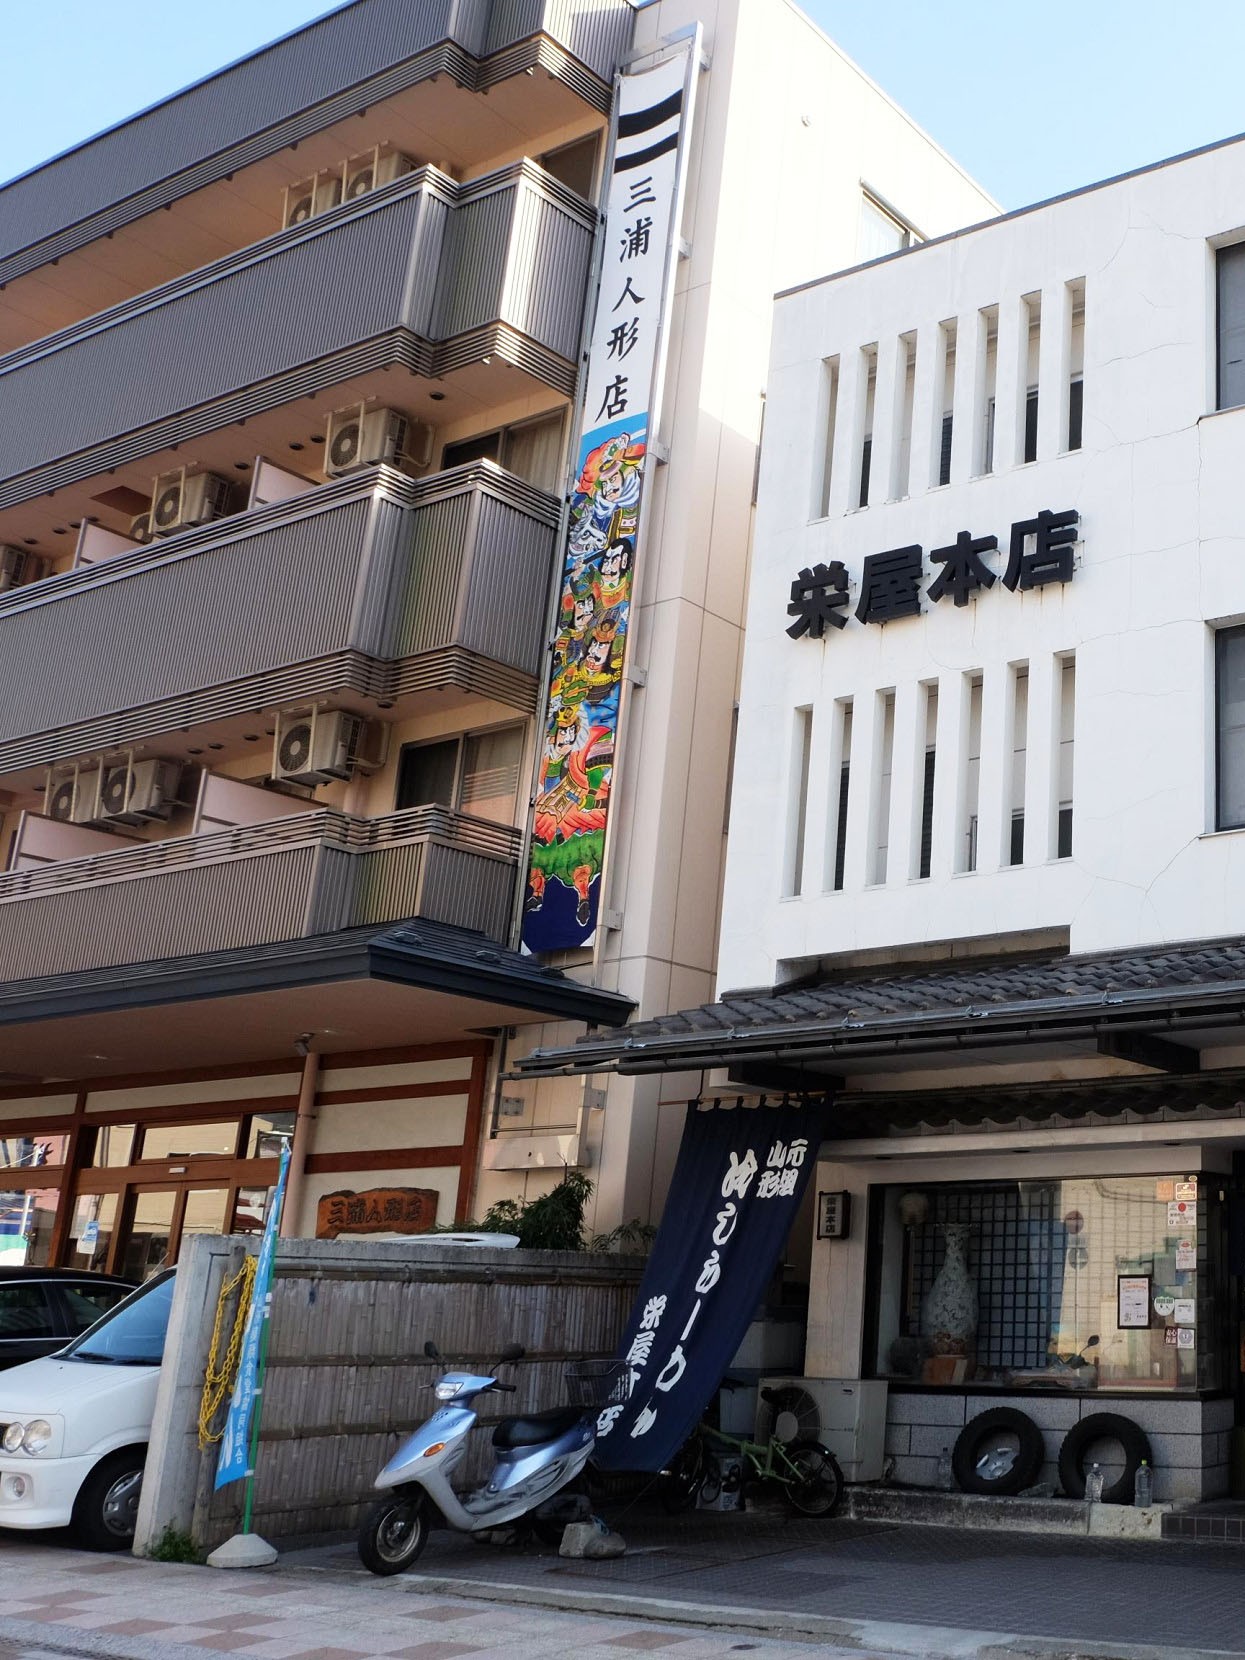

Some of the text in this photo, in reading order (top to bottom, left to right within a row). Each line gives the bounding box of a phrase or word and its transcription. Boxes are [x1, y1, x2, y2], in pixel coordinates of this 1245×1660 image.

[595, 176, 656, 423] 三浦人形店
[785, 509, 1078, 640] 栄屋本店
